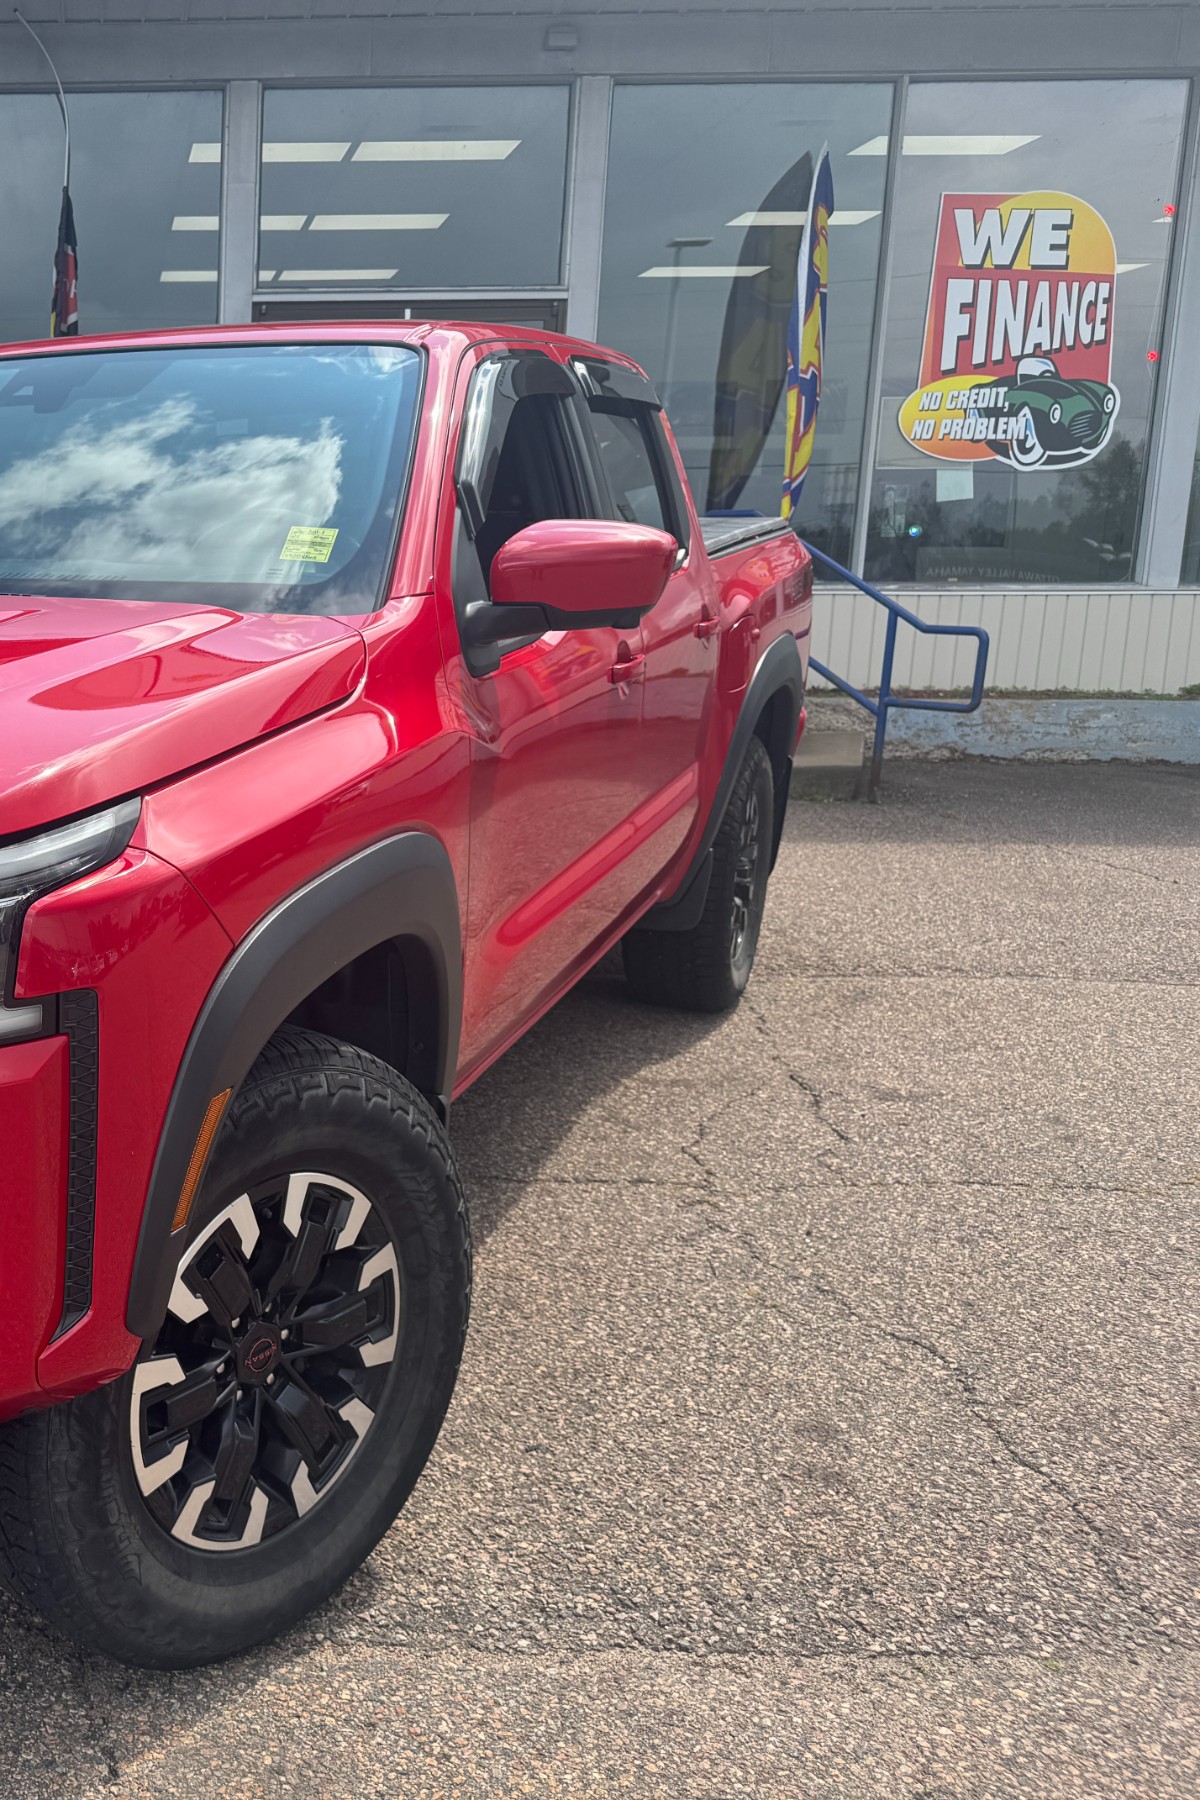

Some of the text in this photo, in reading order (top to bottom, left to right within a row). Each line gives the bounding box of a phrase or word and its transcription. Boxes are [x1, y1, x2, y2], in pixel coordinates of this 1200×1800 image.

[954, 208, 1073, 269] WE
[940, 278, 1111, 375] FINANCE
[918, 387, 1009, 411] NO CREDIT,
[910, 416, 1028, 440] NO PROBLEM
